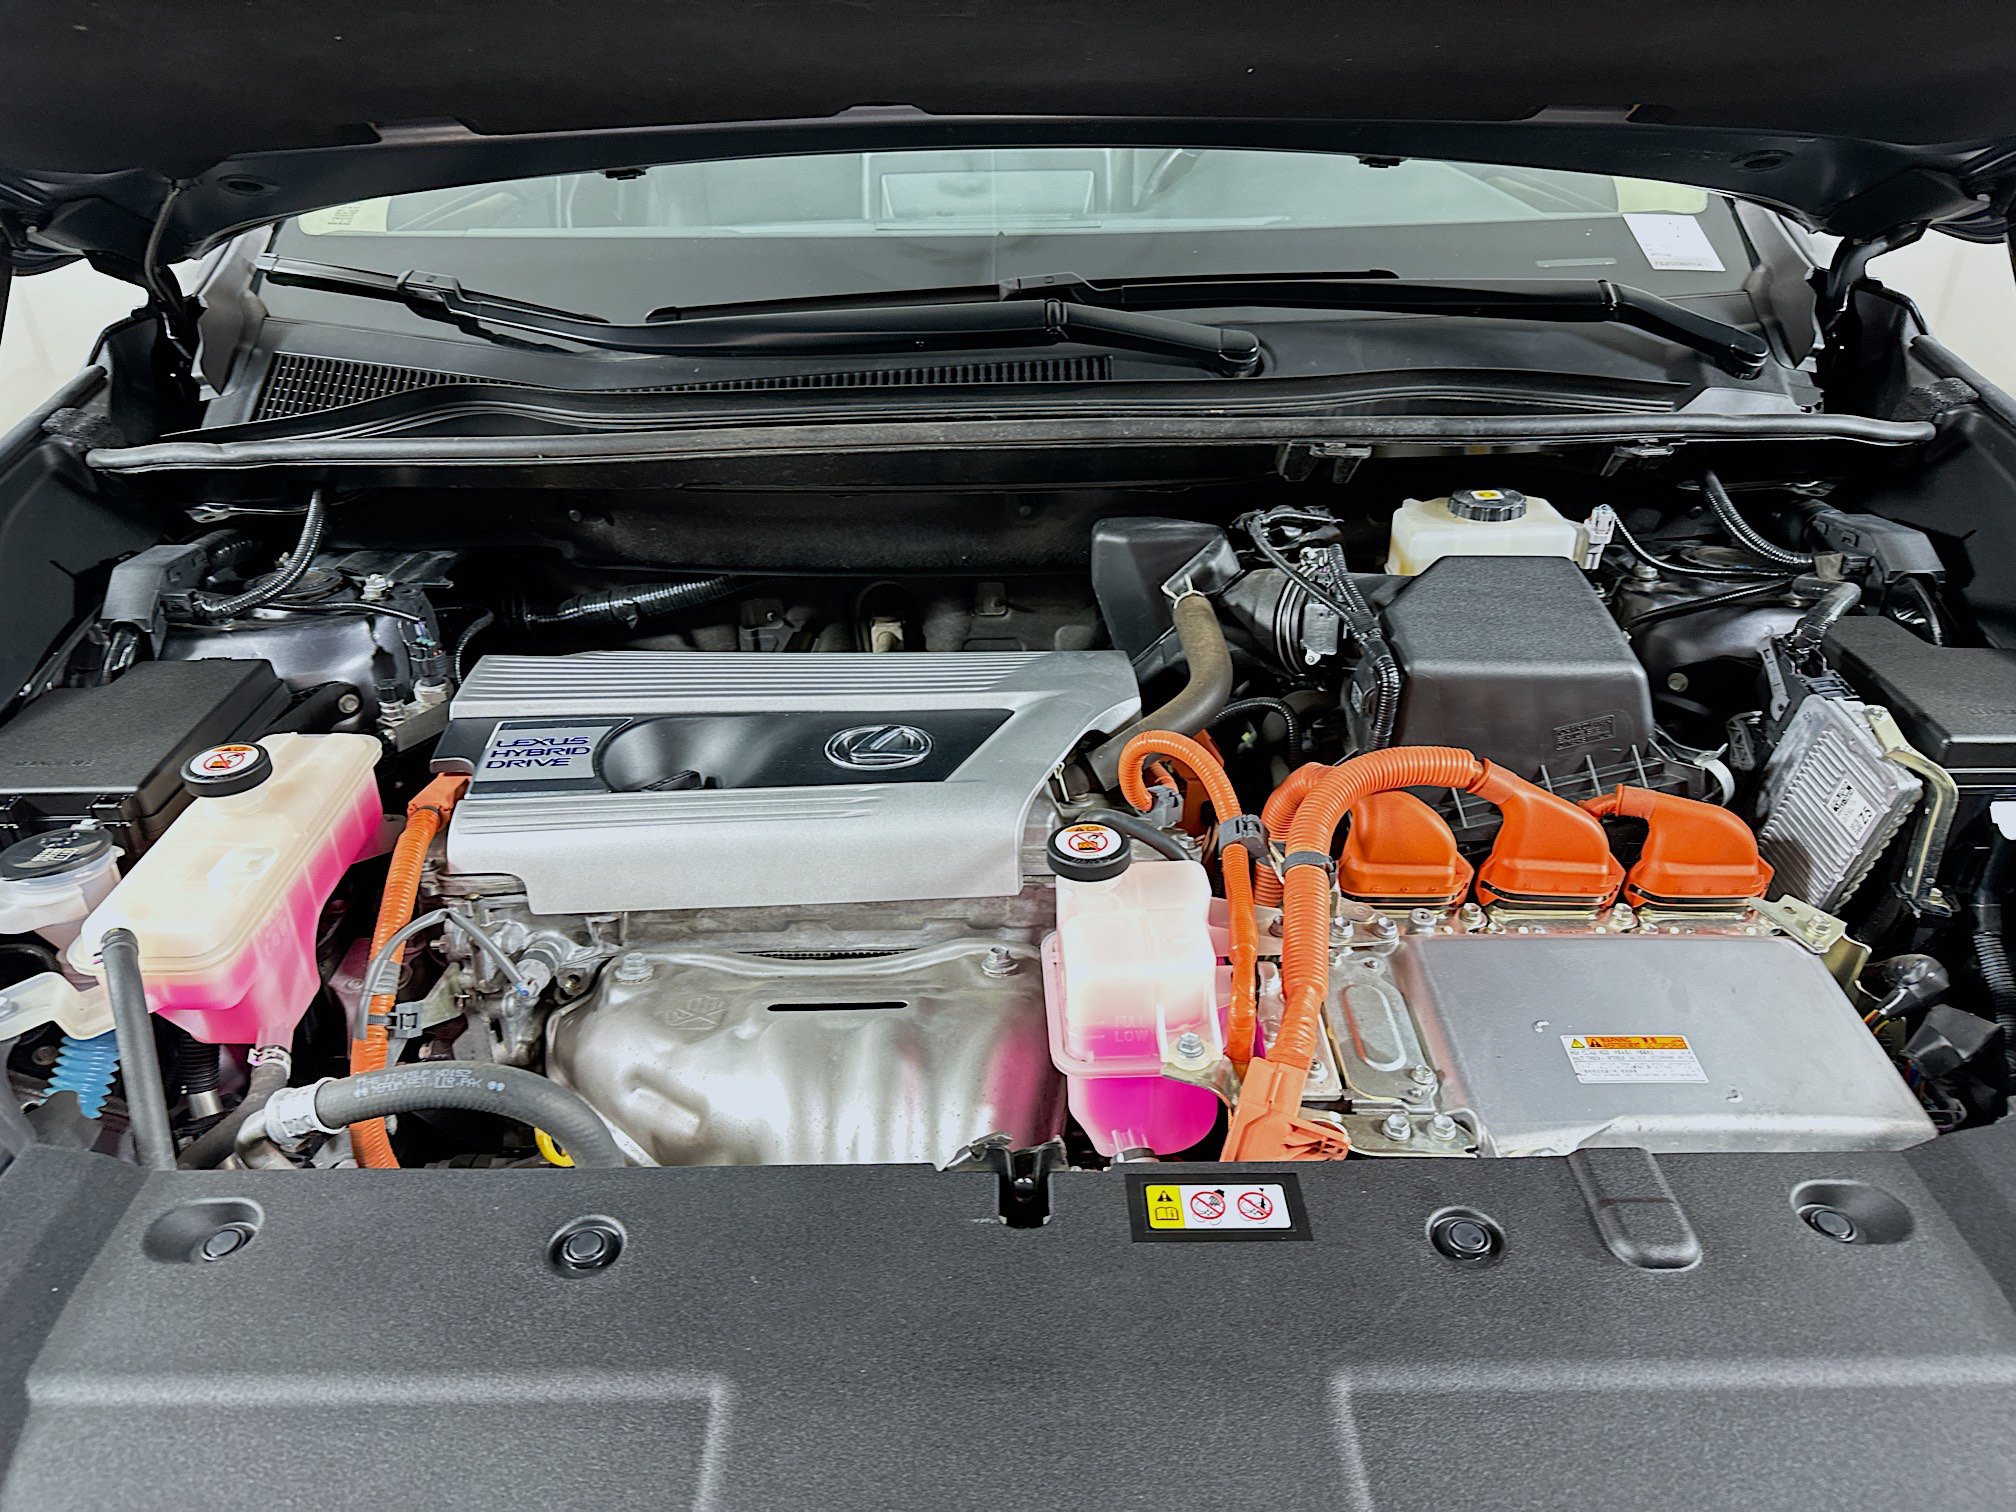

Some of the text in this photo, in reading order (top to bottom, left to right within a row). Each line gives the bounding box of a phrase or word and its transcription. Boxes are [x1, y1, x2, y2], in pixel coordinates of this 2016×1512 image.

[496, 736, 590, 748] LEXUS
[490, 746, 591, 758] HYBRID
[485, 757, 572, 769] DRIVE
[1114, 1030, 1149, 1042] LOW
